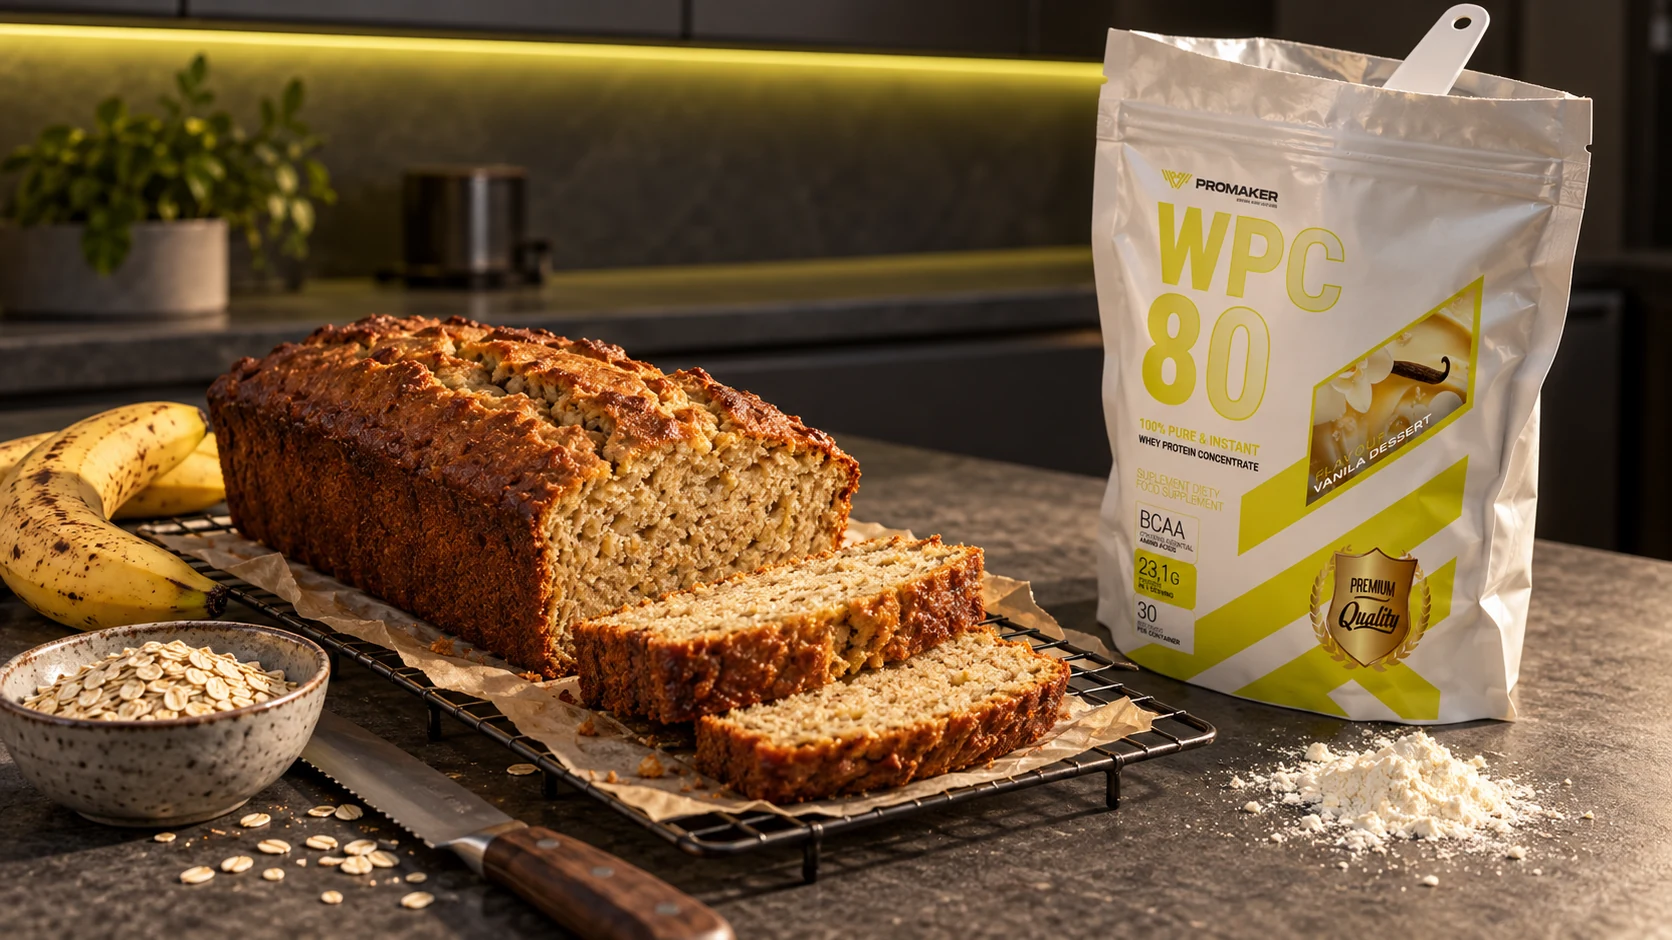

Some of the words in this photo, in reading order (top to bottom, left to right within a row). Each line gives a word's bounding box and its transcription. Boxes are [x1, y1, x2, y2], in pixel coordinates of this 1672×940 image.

[1196, 178, 1278, 202] PROMAKER
[1158, 201, 1345, 313] WPC
[1142, 292, 1271, 421] 80
[1140, 418, 1166, 435] 100%
[1168, 425, 1197, 443] PURE
[1199, 432, 1207, 444] &
[1209, 435, 1260, 456] INSTANT
[1313, 457, 1366, 493] VANILA
[1369, 413, 1432, 460] DESSERT
[1138, 434, 1161, 448] WHEY
[1162, 440, 1196, 458] PROTEIN
[1197, 449, 1260, 473] CONCENTRATE
[1162, 486, 1225, 511] SUPPLEMENT
[1192, 483, 1221, 499] DIETY
[1140, 509, 1186, 540] BCAA
[1350, 577, 1395, 598] PREMIUM
[1137, 601, 1157, 623] 30
[1338, 601, 1400, 634] Quality
